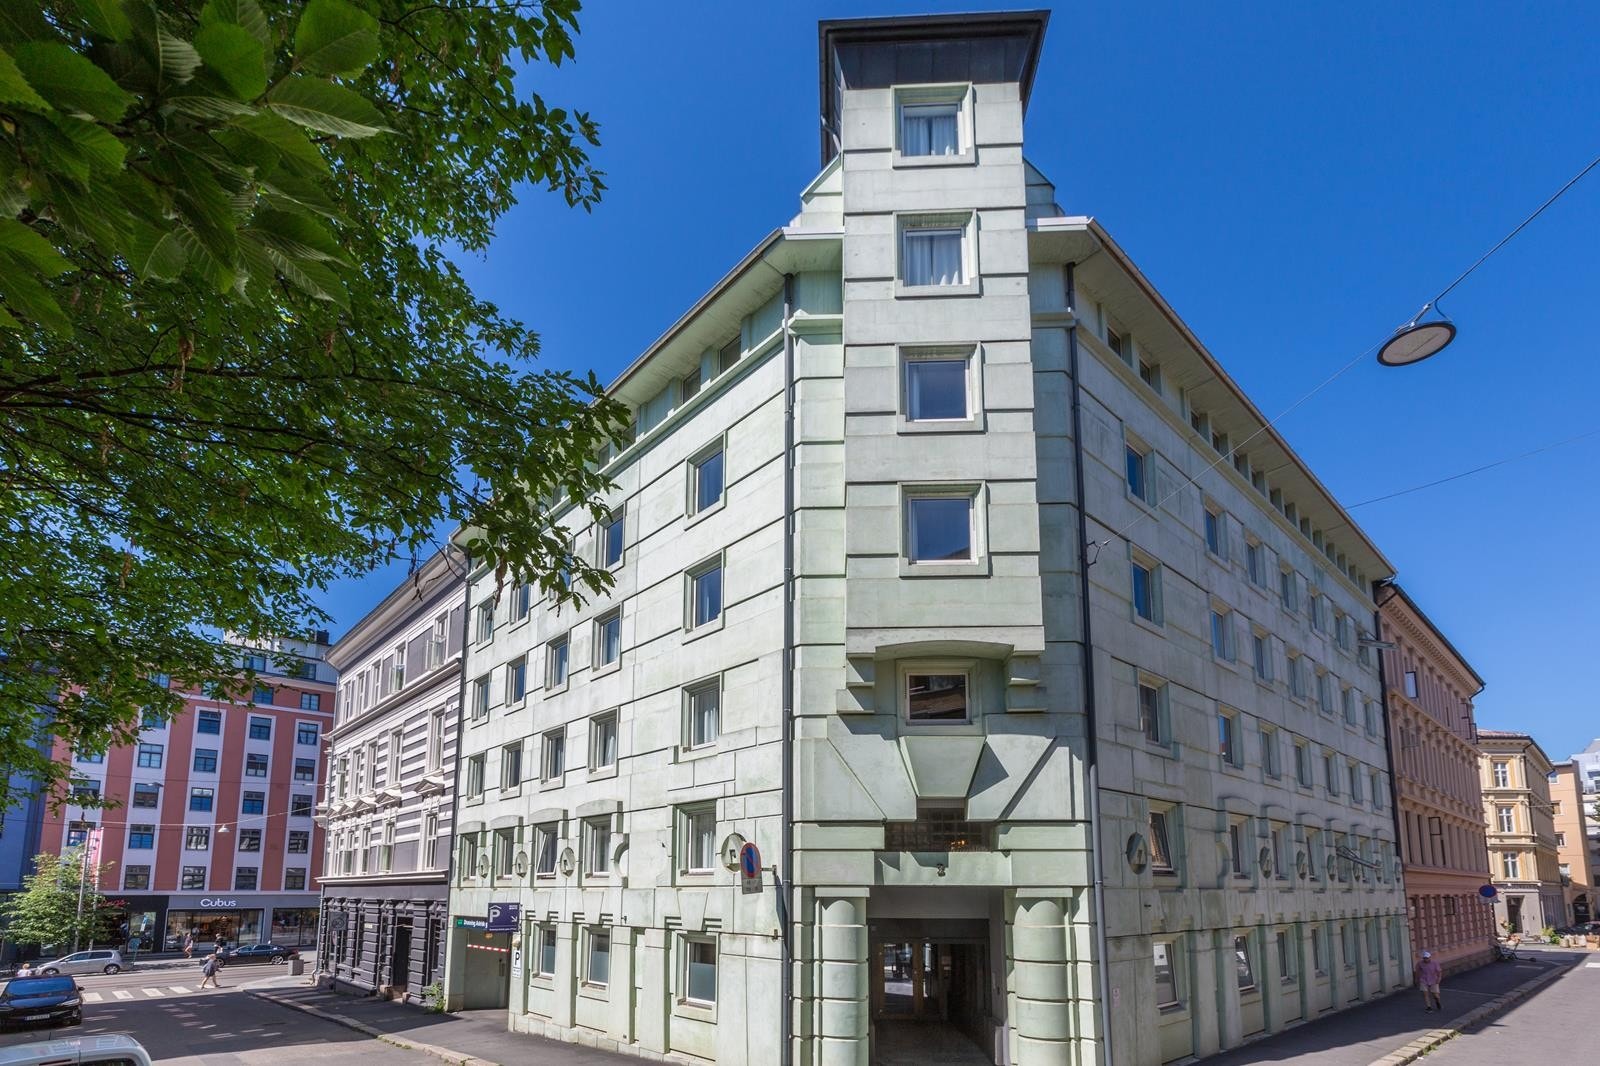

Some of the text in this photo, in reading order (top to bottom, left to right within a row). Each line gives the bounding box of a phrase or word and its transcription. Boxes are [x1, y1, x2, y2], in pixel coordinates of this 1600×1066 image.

[200, 898, 237, 907] Cubus
[489, 909, 501, 923] P
[514, 952, 520, 966] P
